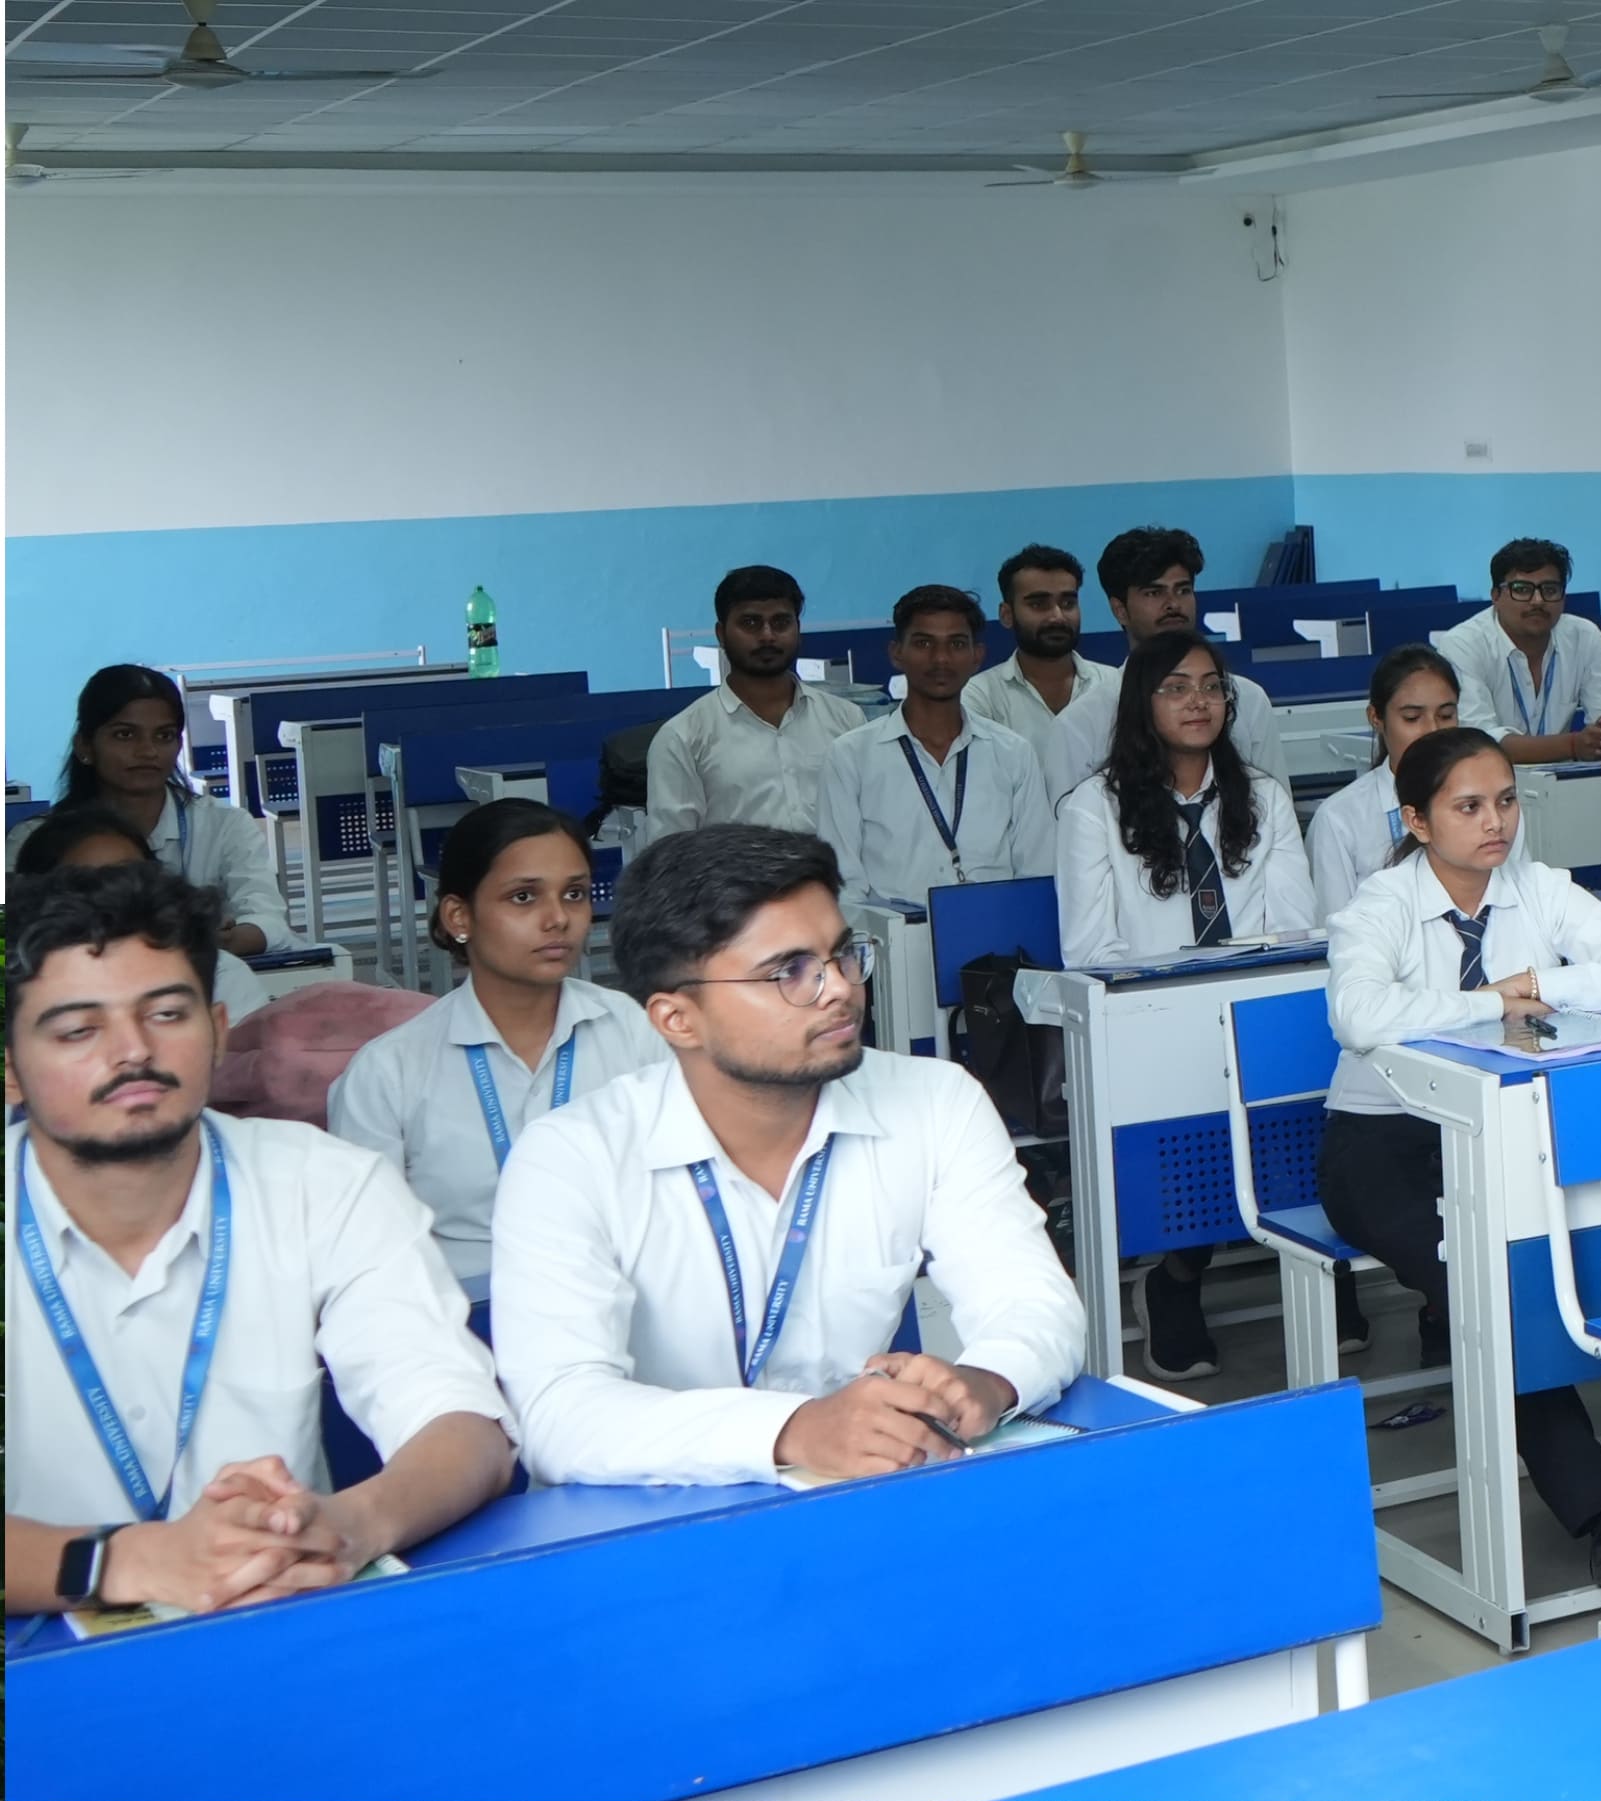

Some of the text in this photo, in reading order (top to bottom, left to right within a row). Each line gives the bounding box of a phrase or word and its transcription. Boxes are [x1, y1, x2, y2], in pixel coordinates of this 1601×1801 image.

[471, 1055, 507, 1142] RAMA UNIVERSITY
[796, 1196, 813, 1226] RAMA
[19, 1221, 74, 1339] RAMA UNIVERSITY
[197, 1215, 231, 1337] RAMA UNIVERSITY
[721, 1233, 744, 1322] RAMA UNIVERSITY
[750, 1279, 791, 1367] RAMA UNIVERSITY
[86, 1384, 148, 1498] RAMA UNIVERSITY
